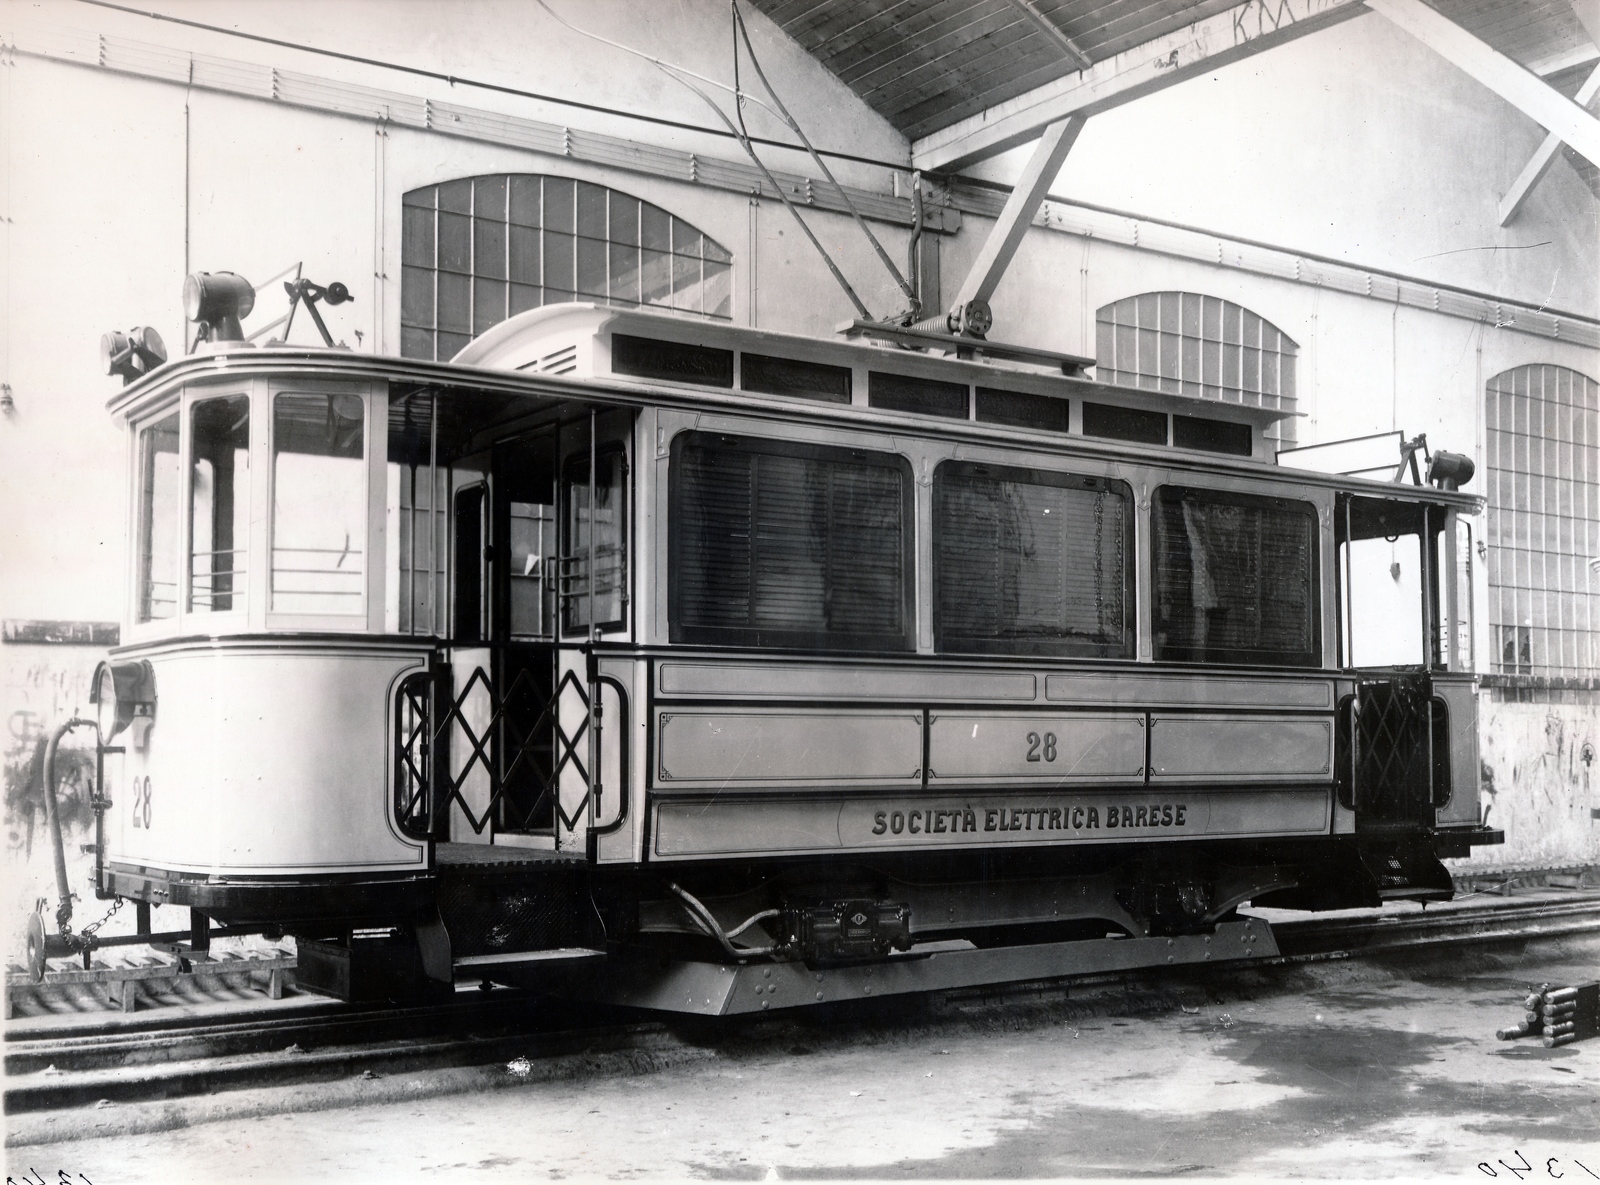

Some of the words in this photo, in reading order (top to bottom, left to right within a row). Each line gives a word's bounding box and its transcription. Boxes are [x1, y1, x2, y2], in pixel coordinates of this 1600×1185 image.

[1026, 731, 1057, 762] 28
[132, 775, 152, 830] 28
[872, 804, 977, 835] SOCIETÀ
[984, 805, 1100, 832] ELETTRICA
[1105, 804, 1187, 828] BARESE
